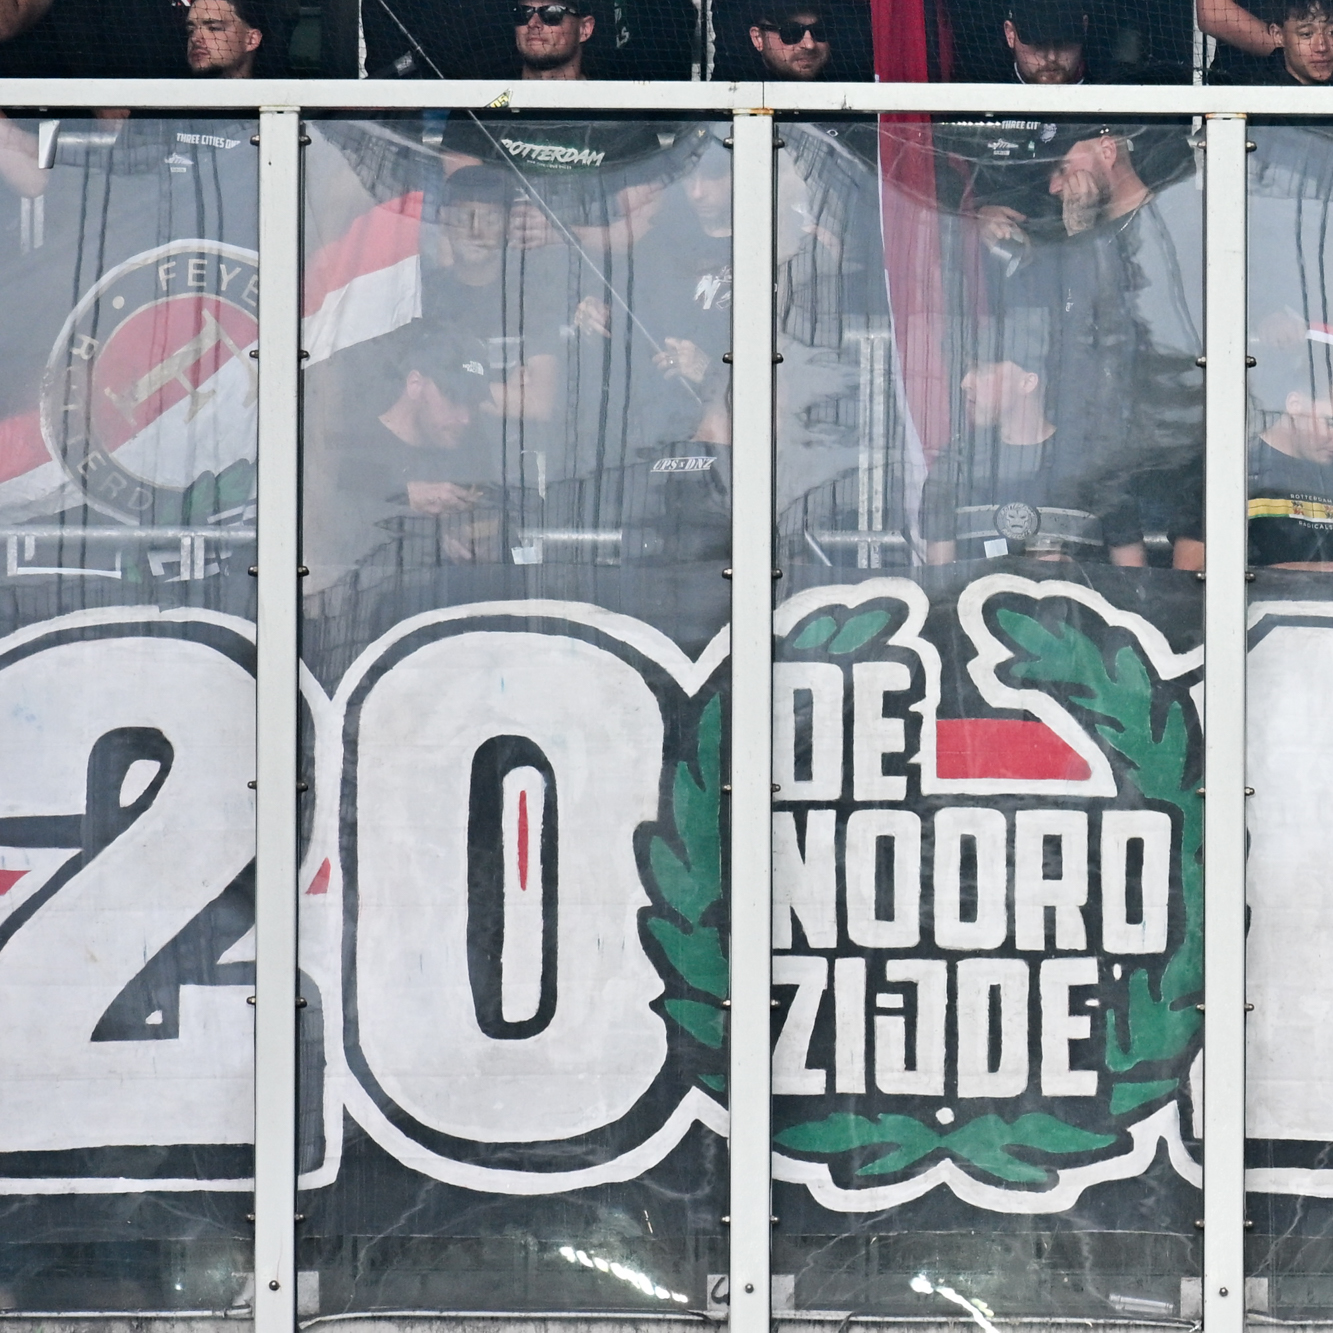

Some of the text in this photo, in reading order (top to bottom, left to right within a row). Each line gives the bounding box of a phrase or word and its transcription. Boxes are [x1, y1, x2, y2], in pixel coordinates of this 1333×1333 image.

[1002, 121, 1026, 131] THREE
[177, 133, 200, 146] THREE
[201, 136, 225, 148] CITIES
[1290, 493, 1333, 504] ROTTERDAM
[1298, 520, 1333, 531] RADICALS
[773, 662, 912, 802] DE
[773, 807, 1172, 954] NOORD
[773, 956, 1100, 1099] ZIJDE
